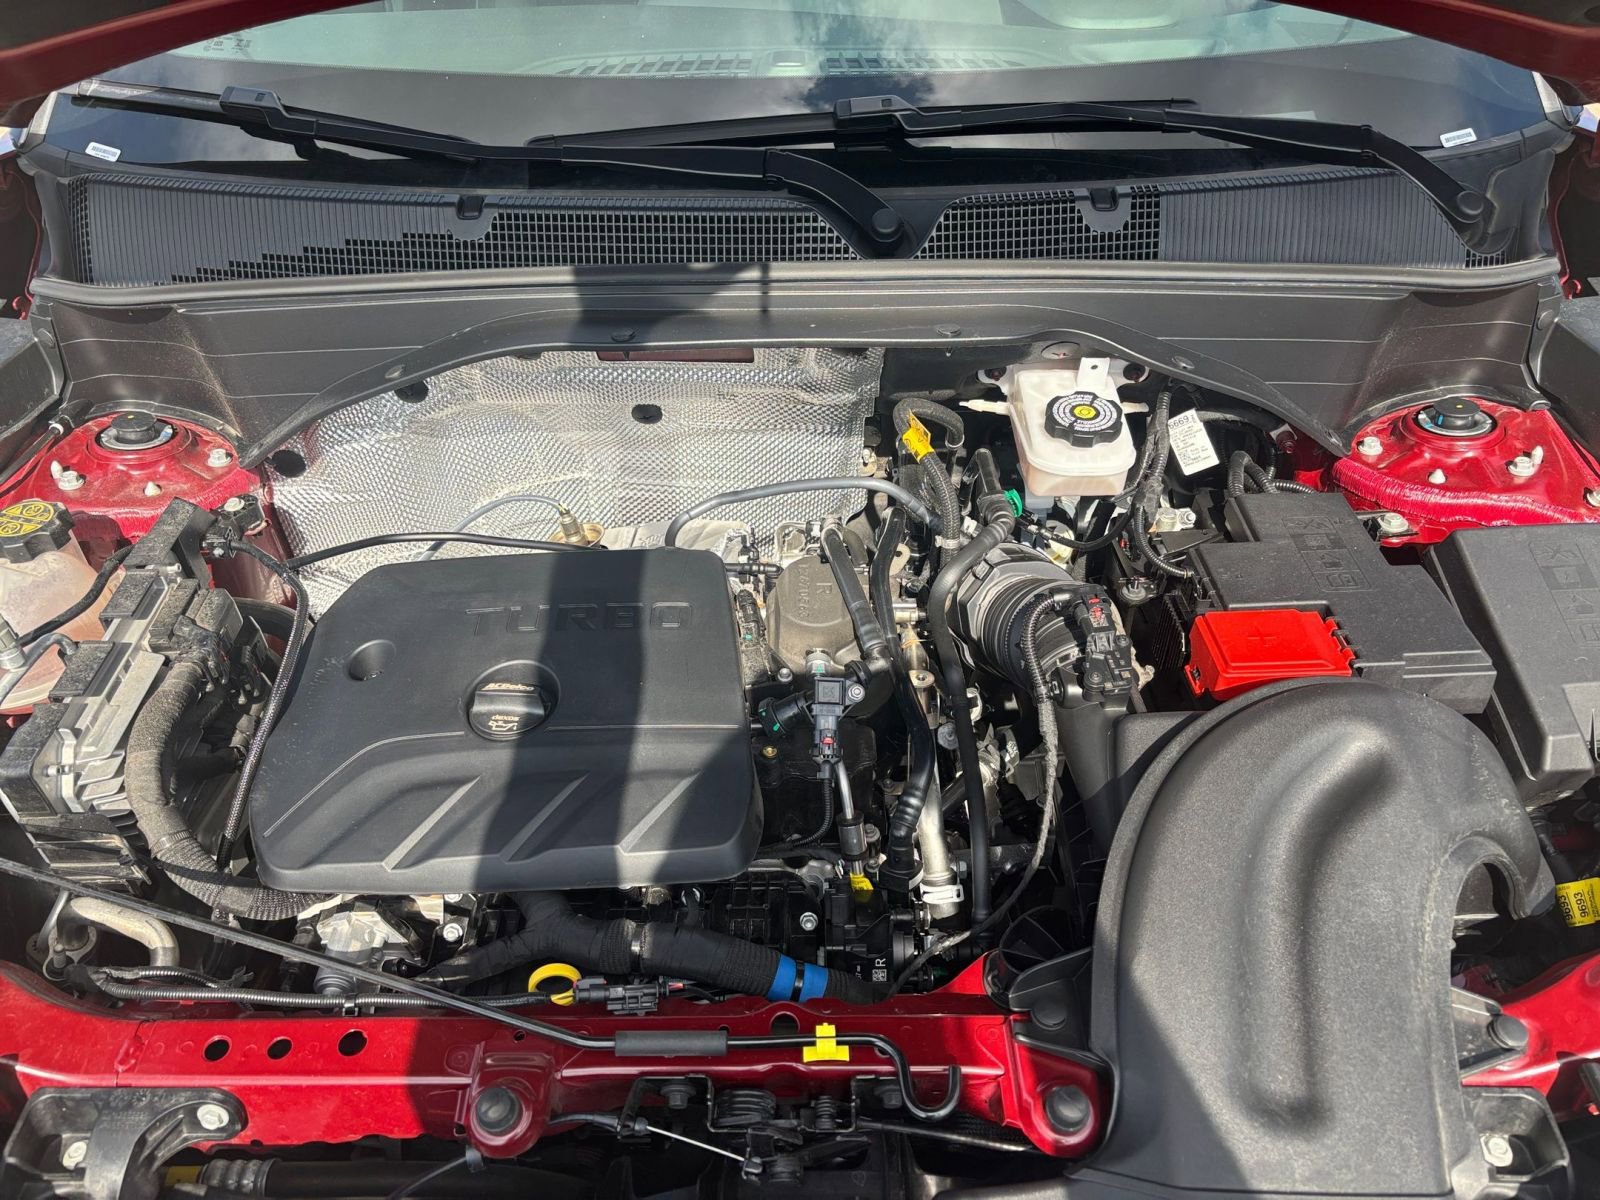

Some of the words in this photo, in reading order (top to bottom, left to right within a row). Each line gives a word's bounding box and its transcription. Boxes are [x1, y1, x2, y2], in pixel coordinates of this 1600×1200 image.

[816, 583, 832, 594] R
[464, 601, 692, 637] TURBO
[481, 682, 535, 691] ACDelco
[491, 714, 520, 722] dexos
[1574, 892, 1588, 918] 9693
[875, 958, 887, 967] R
